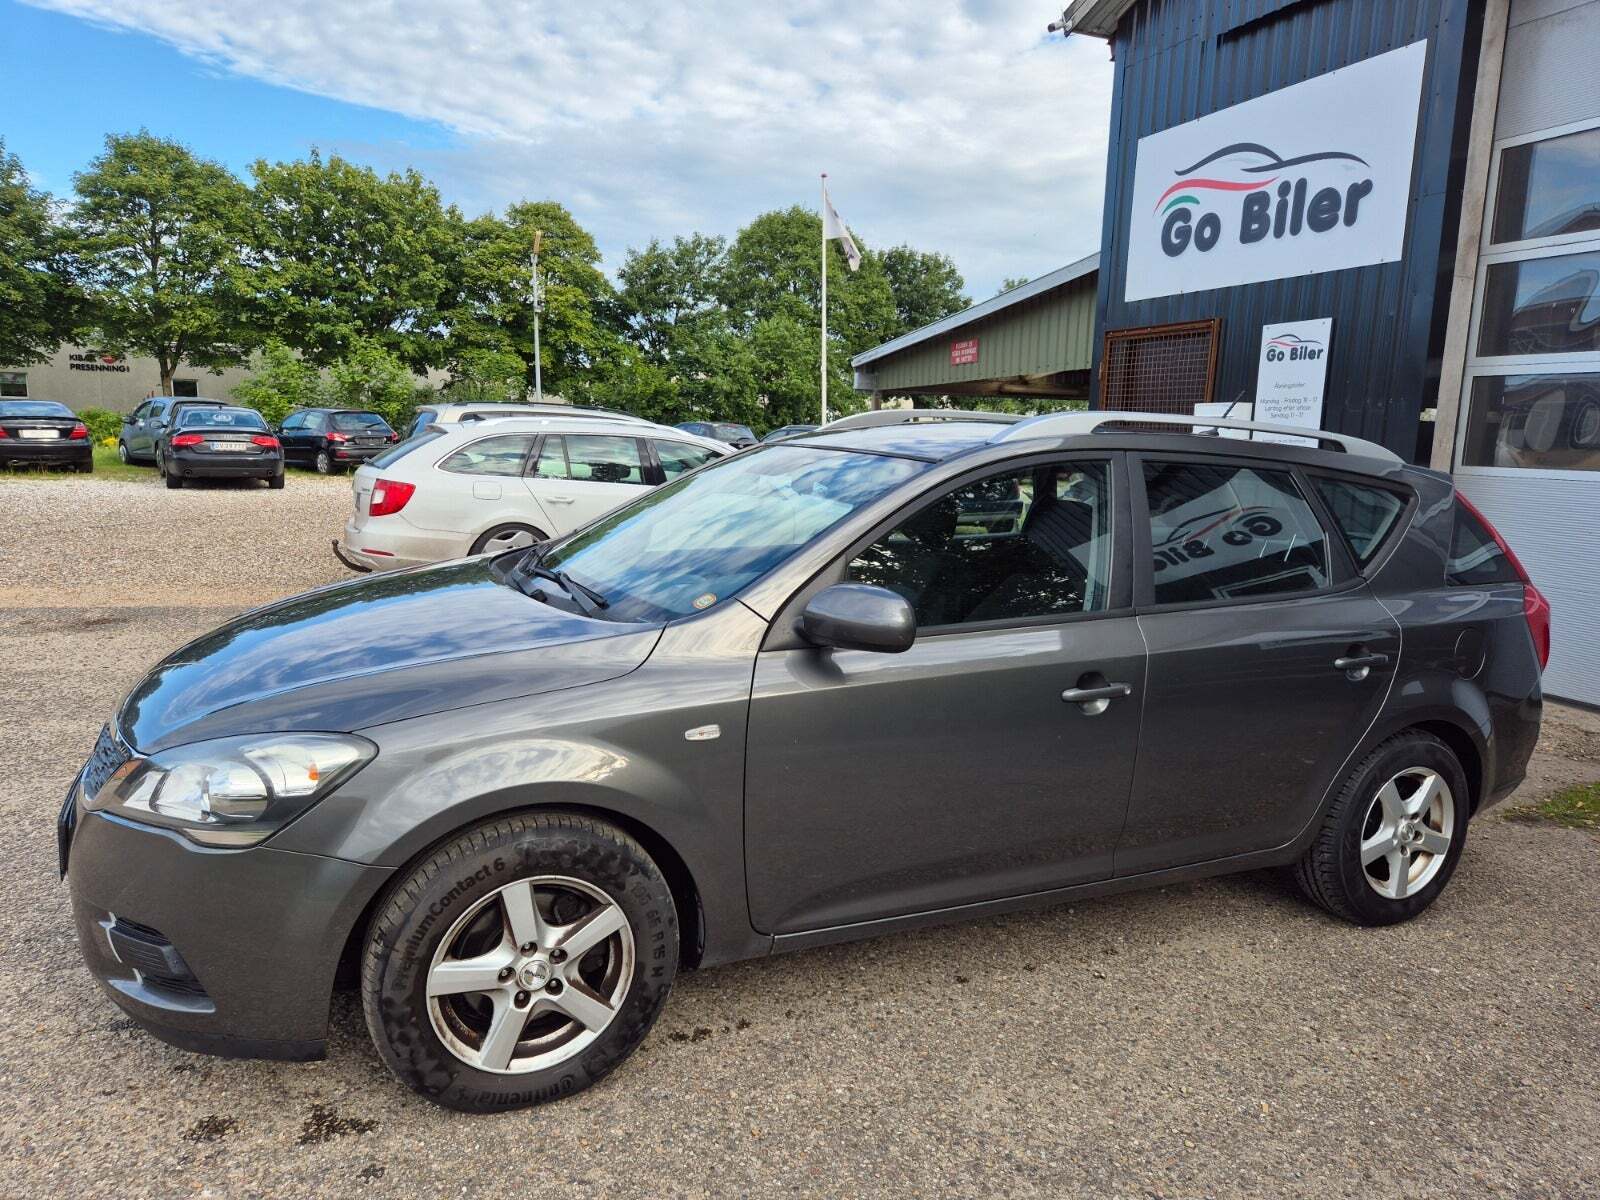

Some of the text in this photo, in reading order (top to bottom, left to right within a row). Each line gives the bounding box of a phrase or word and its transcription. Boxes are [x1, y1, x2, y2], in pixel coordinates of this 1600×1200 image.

[1161, 177, 1373, 257] Go Biler
[1266, 345, 1323, 362] Go Biler
[494, 856, 506, 872] 6
